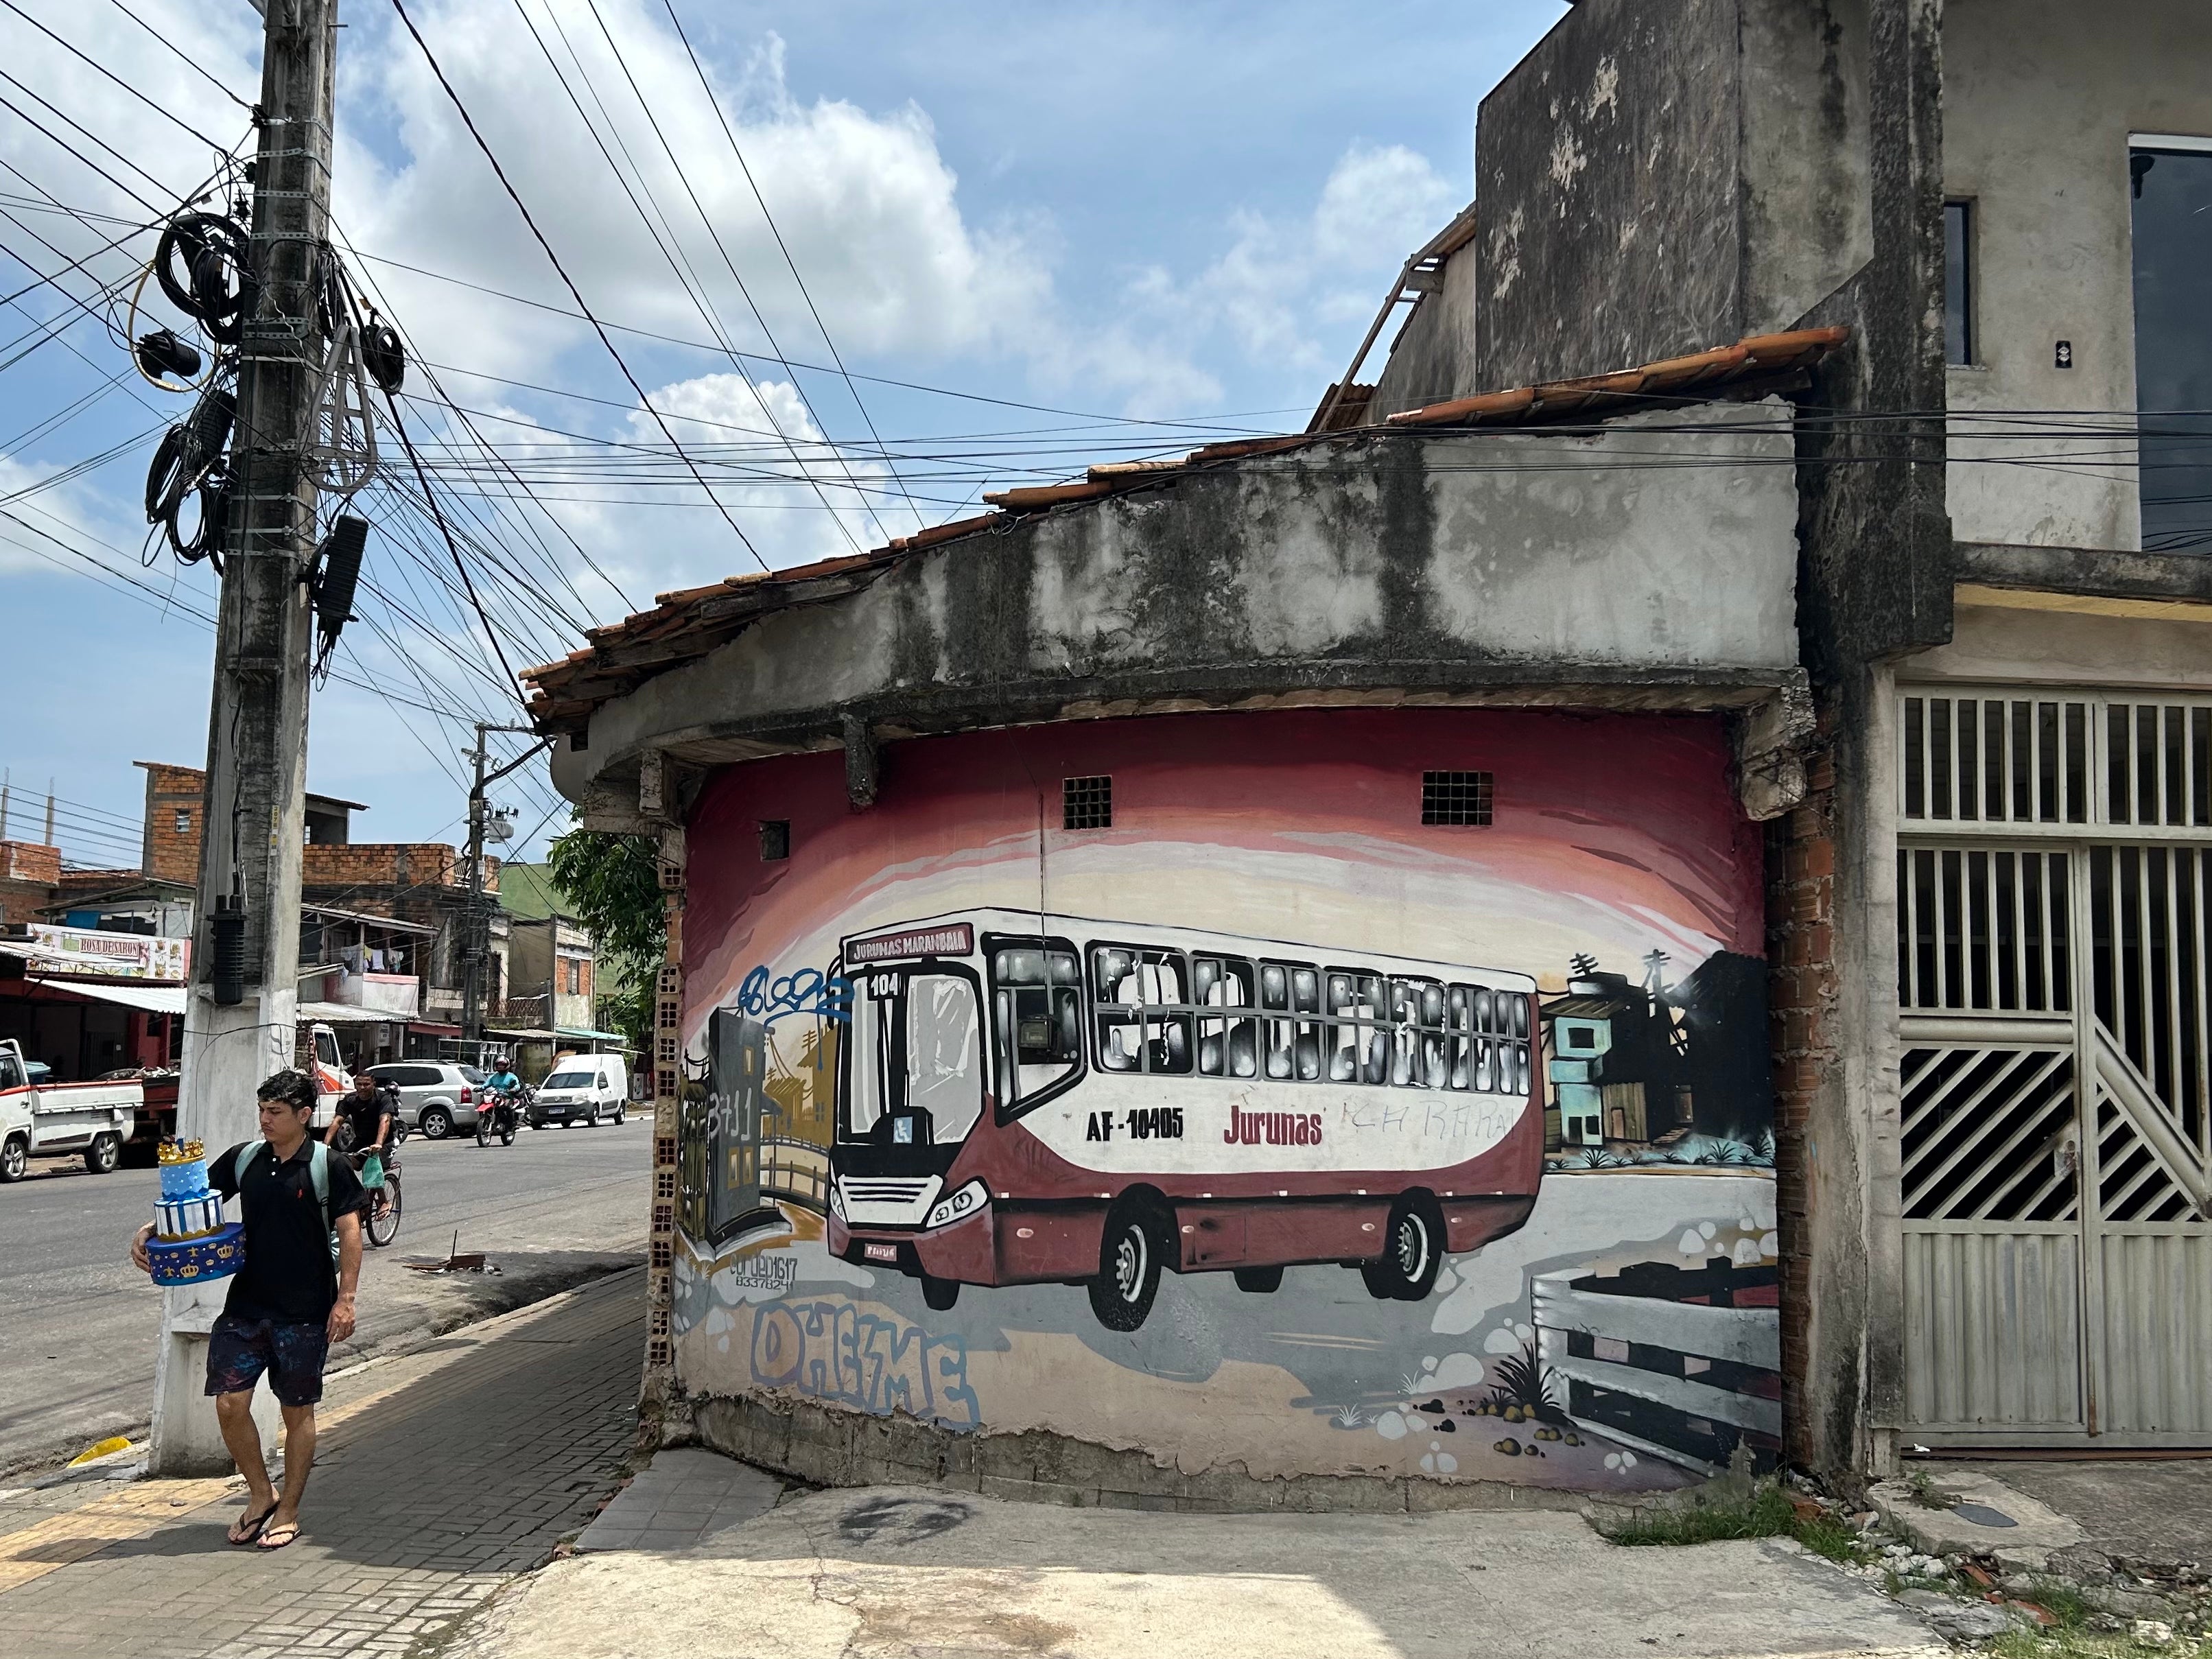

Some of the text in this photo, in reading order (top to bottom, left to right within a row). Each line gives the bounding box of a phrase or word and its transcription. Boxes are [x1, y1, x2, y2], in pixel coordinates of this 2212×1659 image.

[81, 939, 137, 955] ROSA DE SARON
[854, 938, 902, 960] JURUNAS
[871, 972, 898, 996] 104
[1224, 1105, 1323, 1146] Jurunas
